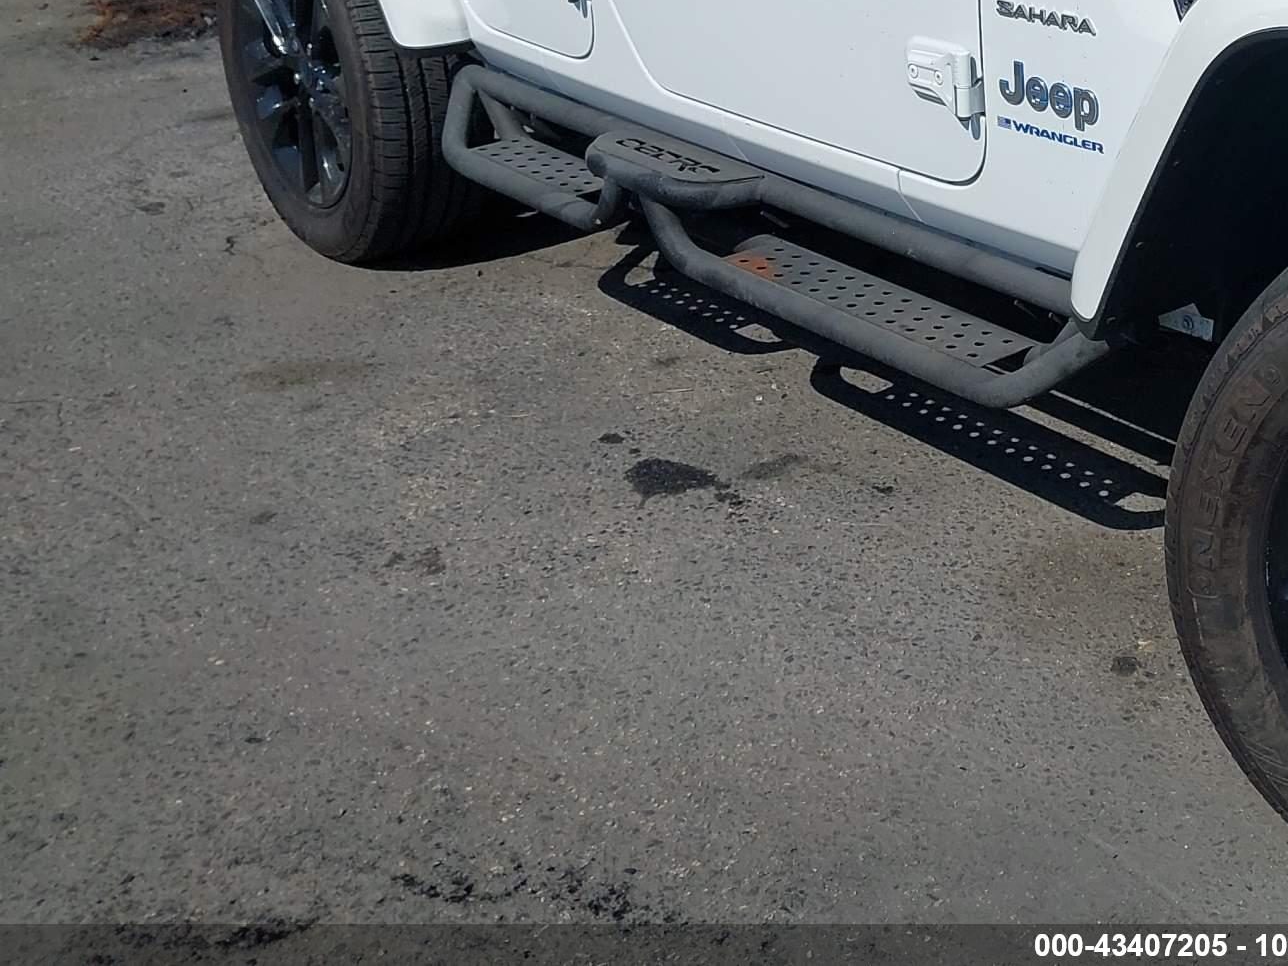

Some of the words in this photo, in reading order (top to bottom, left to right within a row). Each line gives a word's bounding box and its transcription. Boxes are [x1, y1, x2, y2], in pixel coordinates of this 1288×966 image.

[996, 0, 1097, 37] SAHARA
[999, 60, 1100, 132] Jeep
[1012, 120, 1105, 154] WRANGLER
